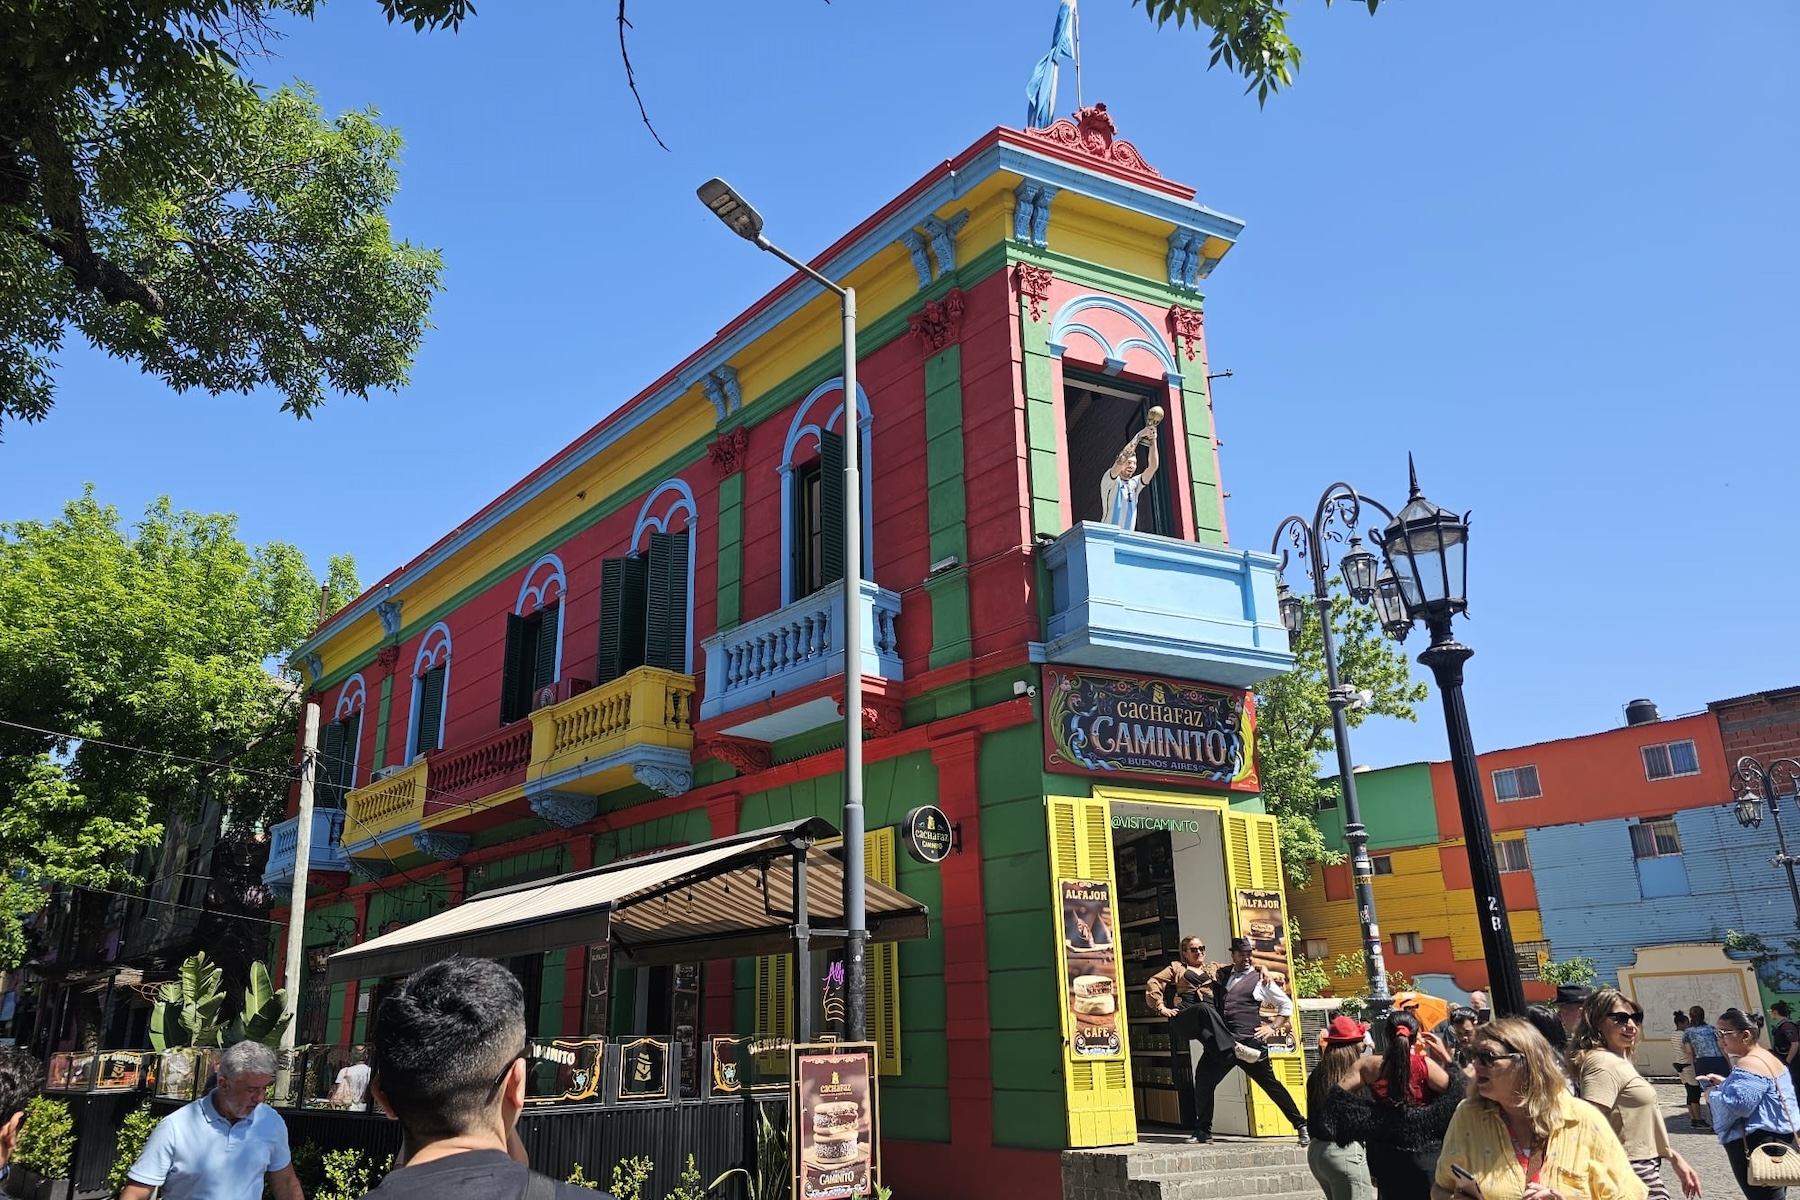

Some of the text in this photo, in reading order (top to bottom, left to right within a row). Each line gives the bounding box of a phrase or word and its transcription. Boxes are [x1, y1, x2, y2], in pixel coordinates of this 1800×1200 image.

[1090, 715, 1227, 766] CAMINITO
[1127, 757, 1199, 772] BUENOS AIRES
[1111, 814, 1199, 833] @VISITCAMINITO
[1065, 889, 1108, 901] ALFAJOR
[1239, 898, 1280, 910] ALFAJOR
[819, 1170, 855, 1186] CAMINITO
